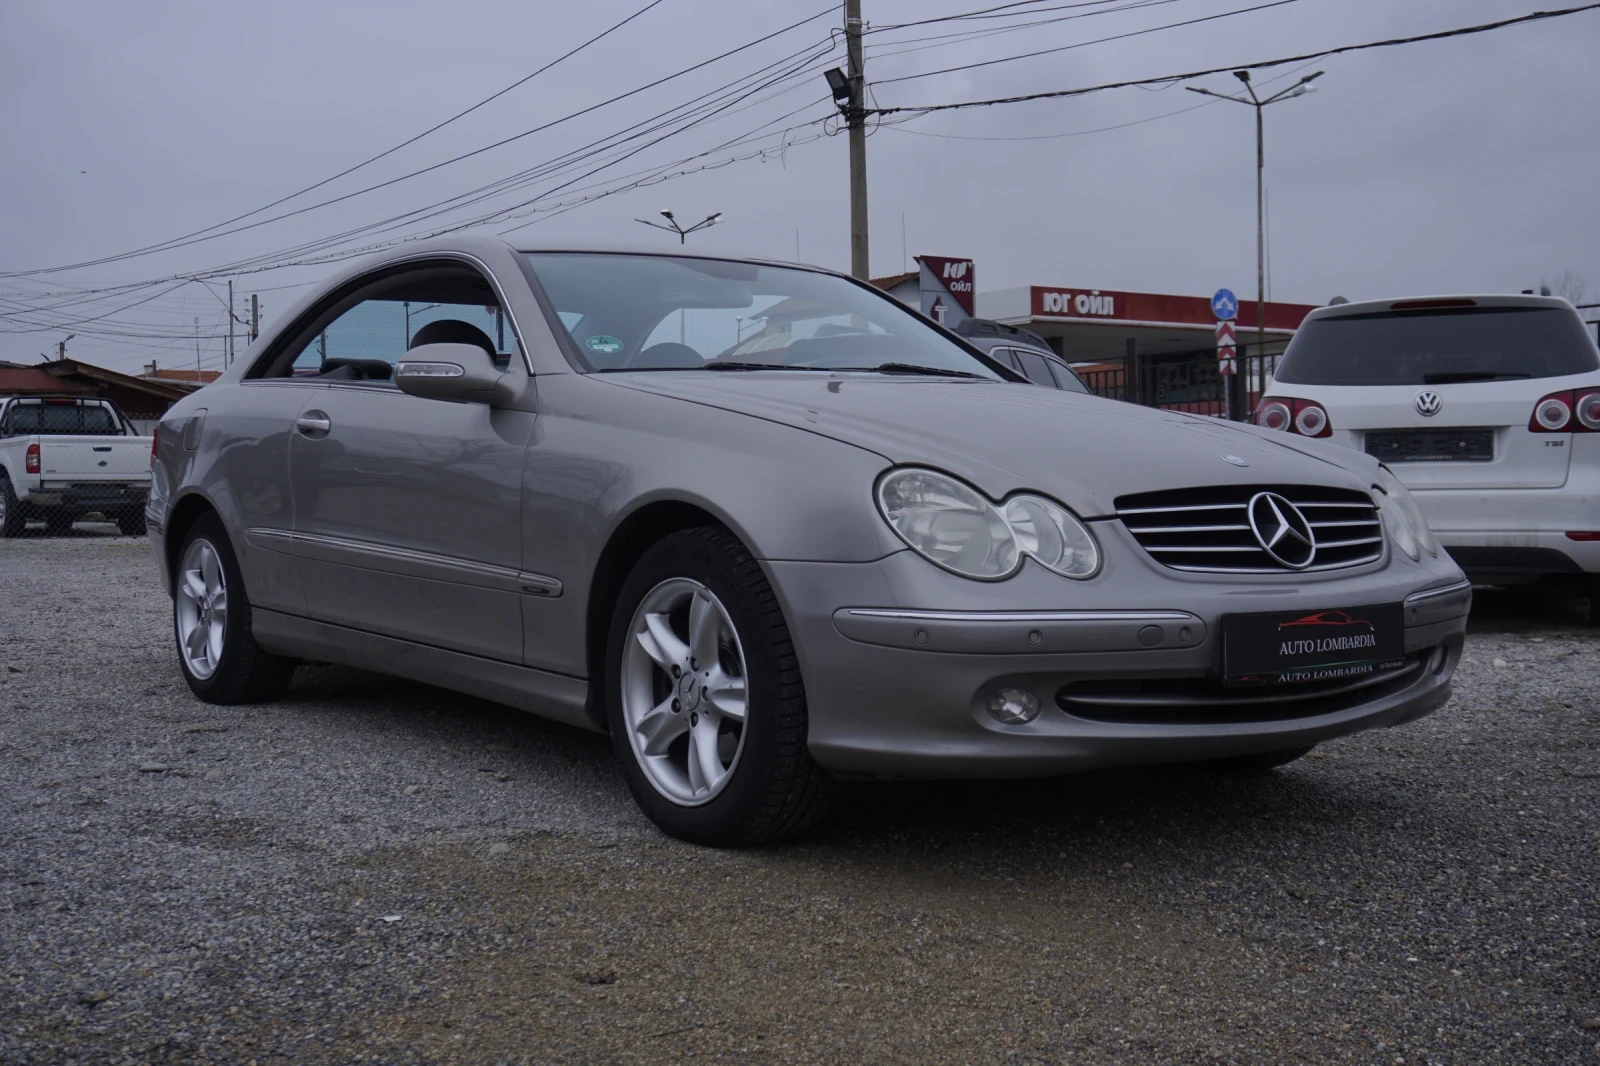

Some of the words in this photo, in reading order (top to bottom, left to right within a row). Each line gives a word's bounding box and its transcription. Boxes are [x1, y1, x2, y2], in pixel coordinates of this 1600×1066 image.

[950, 280, 972, 292] ОЙЛ
[1043, 292, 1072, 313] ЮГ
[1074, 290, 1115, 315] ОЙЛ
[1279, 640, 1314, 656] AUTO
[1317, 634, 1377, 652] LOMBARDIA
[1278, 672, 1311, 682] AUTO
[1313, 665, 1374, 679] LOMBARDIA
